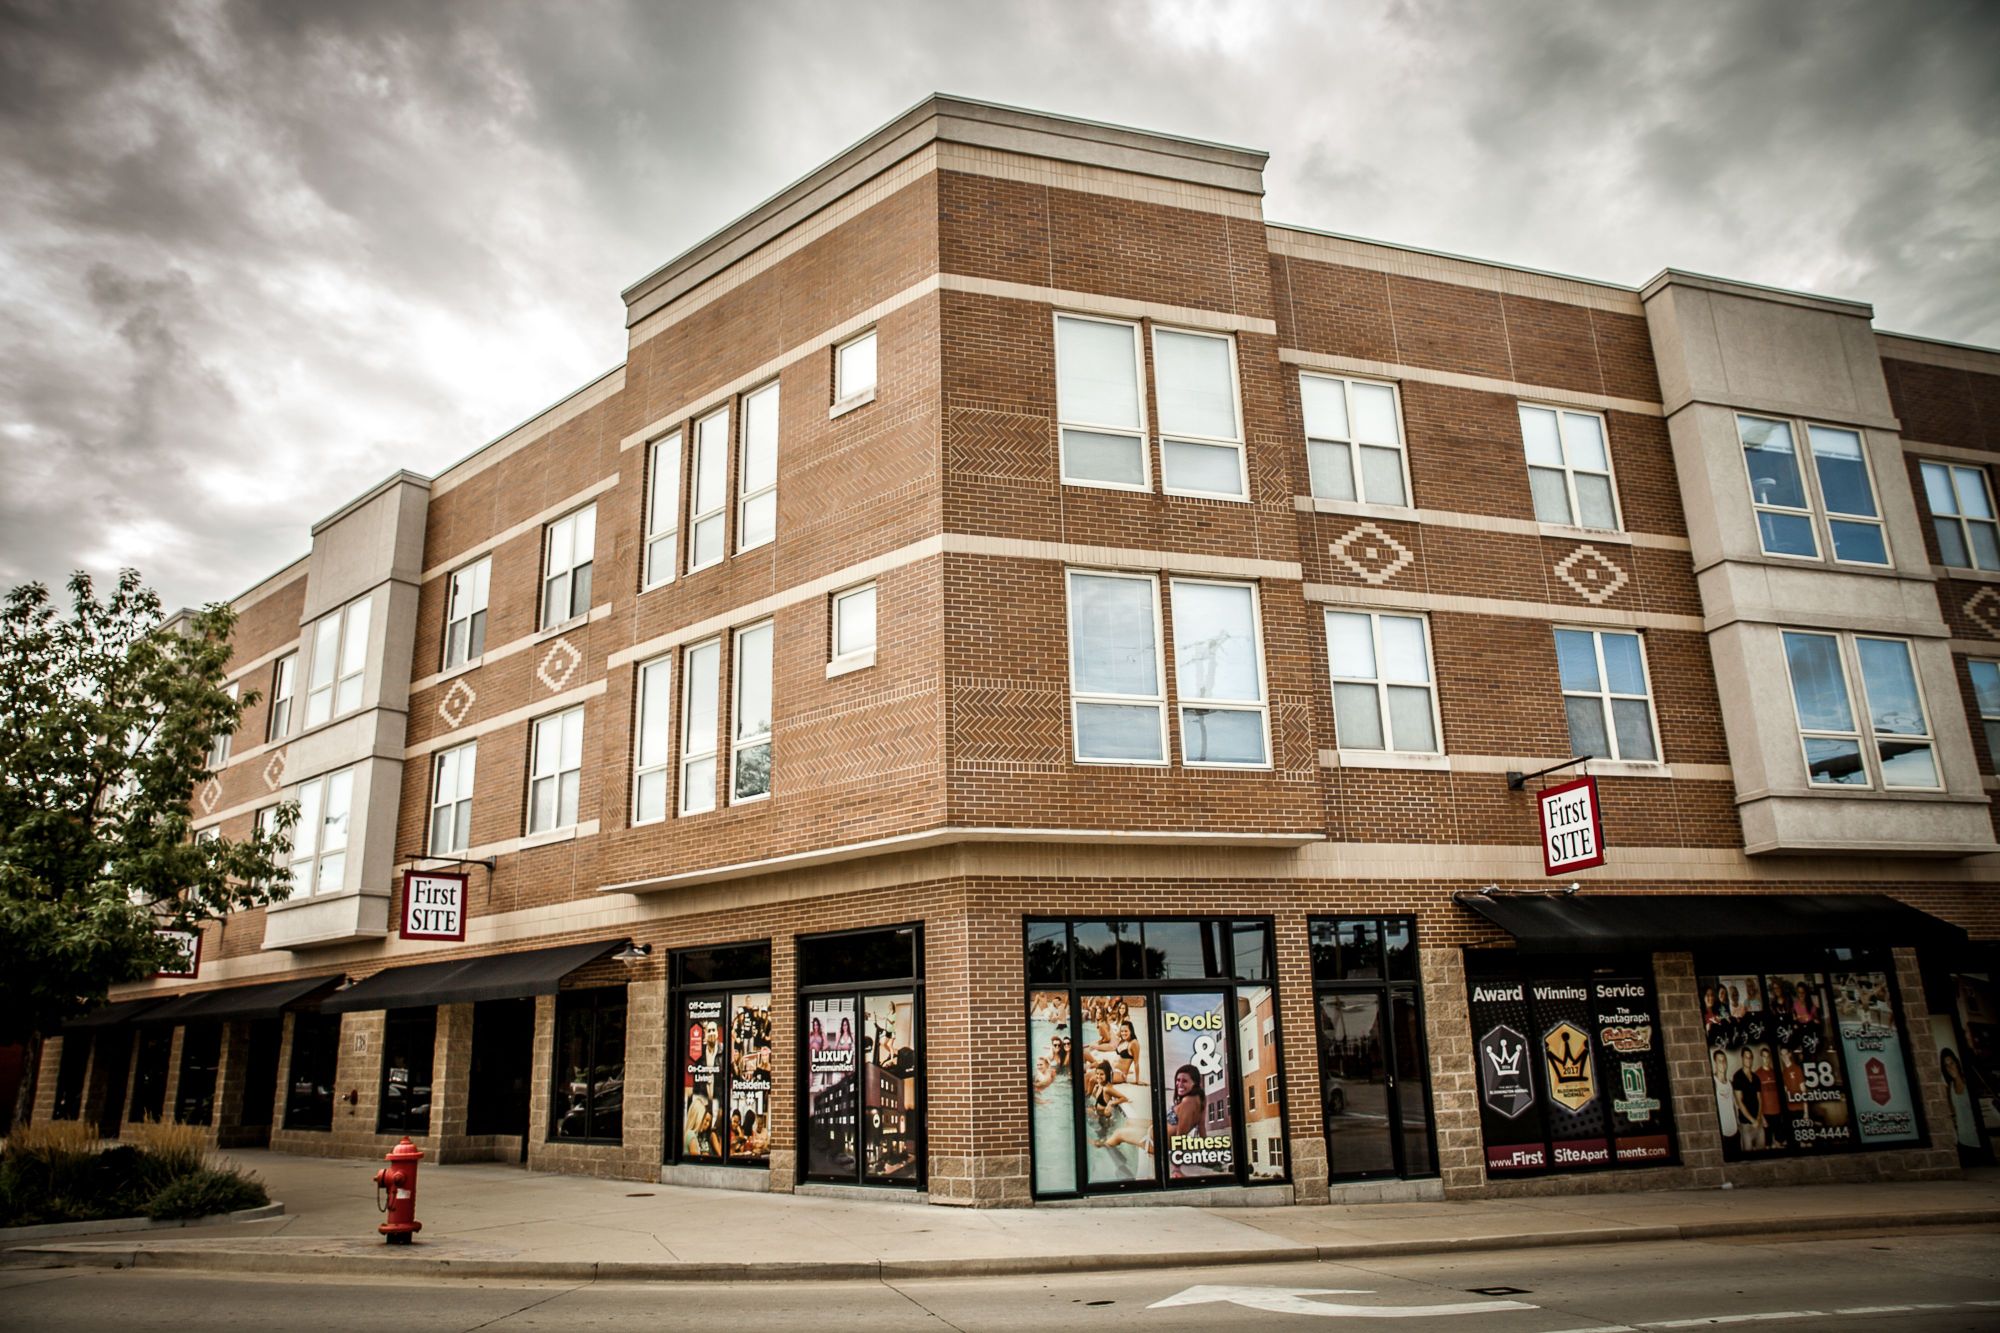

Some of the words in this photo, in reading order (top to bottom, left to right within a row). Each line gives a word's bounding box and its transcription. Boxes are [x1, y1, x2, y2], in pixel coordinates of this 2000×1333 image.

[1547, 797, 1588, 829] First
[1551, 827, 1593, 862] SITE
[414, 880, 457, 906] First
[411, 908, 457, 932] SITE
[1473, 985, 1524, 1002] Award
[1533, 986, 1588, 1001] Winning
[1596, 983, 1645, 999] Service
[1165, 1011, 1223, 1031] Pools
[1598, 1013, 1650, 1024] Pantagraph
[1857, 1041, 1885, 1051] Living
[811, 1049, 853, 1064] Luxury
[1190, 1036, 1222, 1075] &
[811, 1064, 854, 1072] Communities
[1563, 1066, 1579, 1075] 2017
[1803, 1061, 1835, 1088] 58
[732, 1079, 770, 1090] Residents
[1787, 1088, 1841, 1102] Locations
[1794, 1126, 1850, 1141] 888-4444
[1171, 1135, 1231, 1151] Fitness
[1171, 1148, 1232, 1165] Centers
[1488, 1150, 1544, 1168] www.First
[1553, 1148, 1609, 1163] SiteApart
[1616, 1146, 1667, 1159] ments.com
